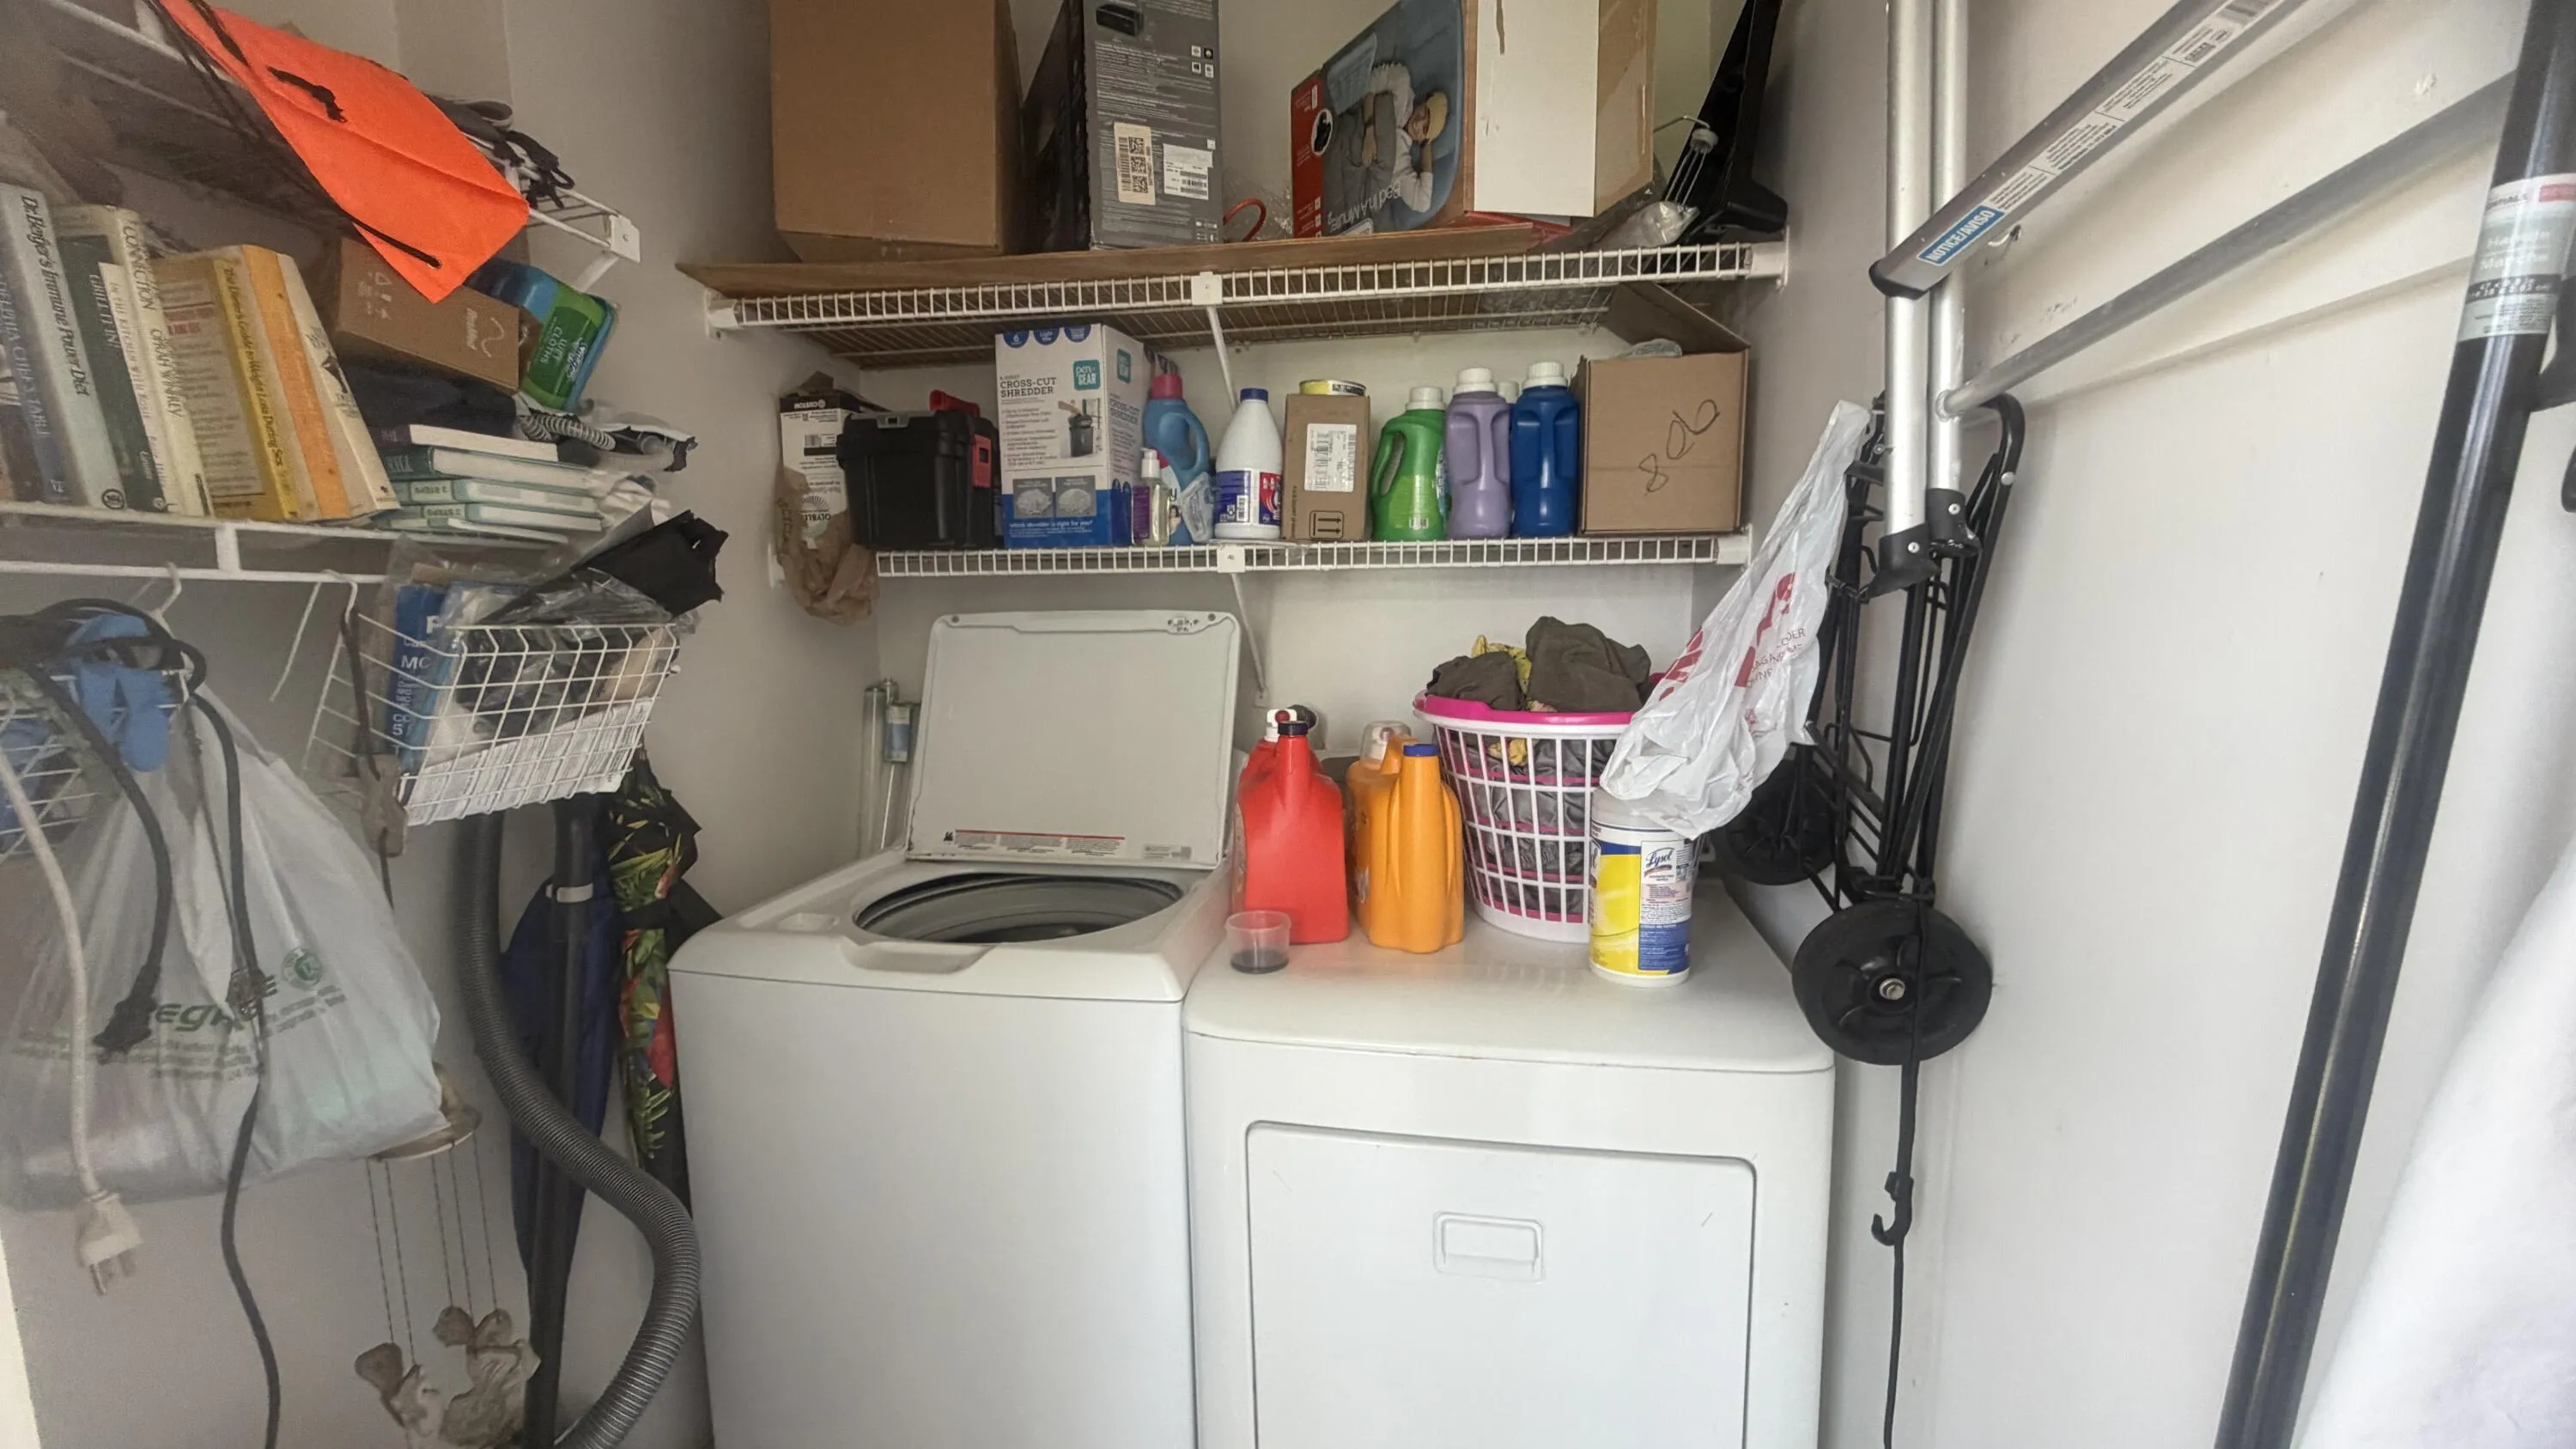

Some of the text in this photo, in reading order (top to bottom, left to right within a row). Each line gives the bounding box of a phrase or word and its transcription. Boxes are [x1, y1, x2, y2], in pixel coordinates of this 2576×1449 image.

[1925, 210, 1996, 262] NOTICE/AVISO
[44, 265, 69, 325] Immune
[59, 326, 82, 368] Power
[71, 366, 89, 398] Diet
[999, 377, 1057, 389] CROSS-CUT
[1078, 373, 1097, 386] GEAR
[1000, 386, 1054, 398] SHREDDER
[1646, 849, 1674, 868] Lysol
